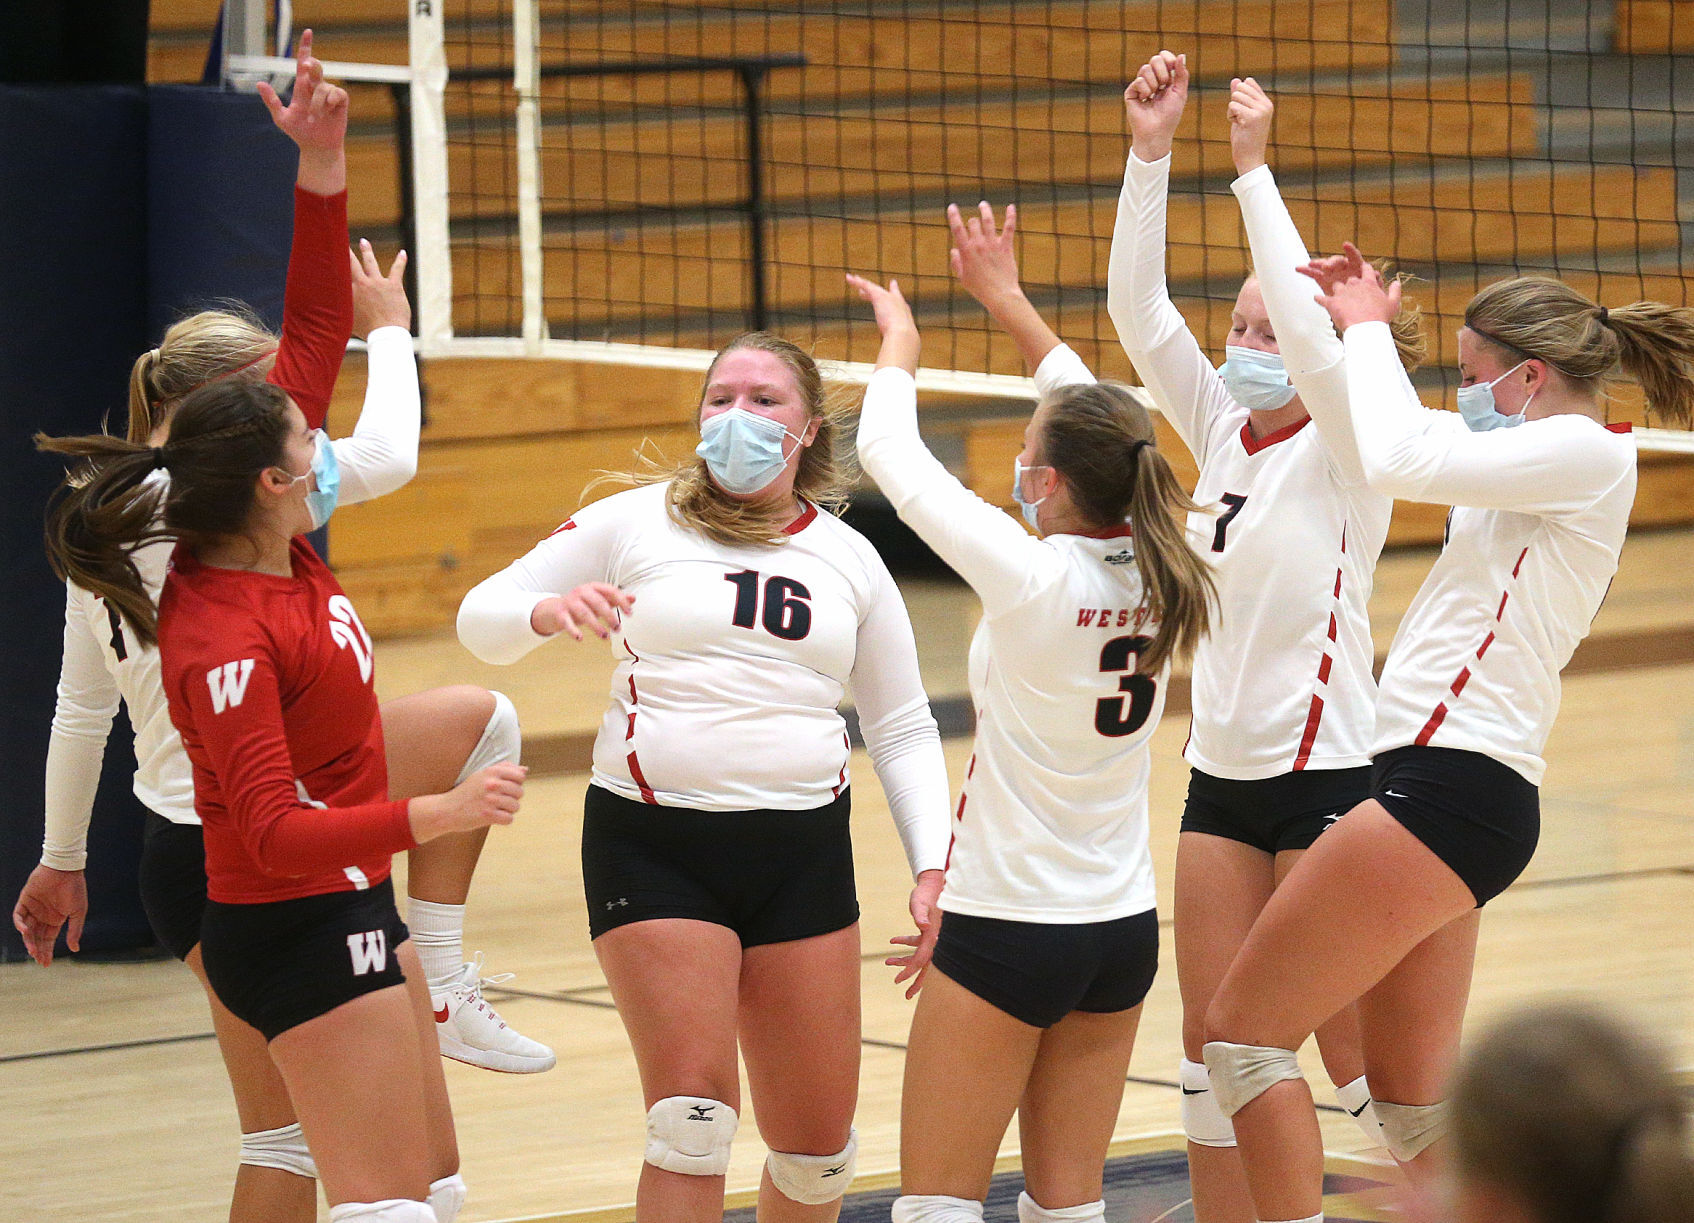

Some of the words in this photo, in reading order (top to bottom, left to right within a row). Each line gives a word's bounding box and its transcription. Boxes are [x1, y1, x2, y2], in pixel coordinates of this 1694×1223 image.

[1211, 492, 1248, 552] 7
[724, 569, 812, 641] 16
[206, 658, 256, 715] W
[1095, 634, 1157, 737] 3
[346, 929, 387, 976] W
